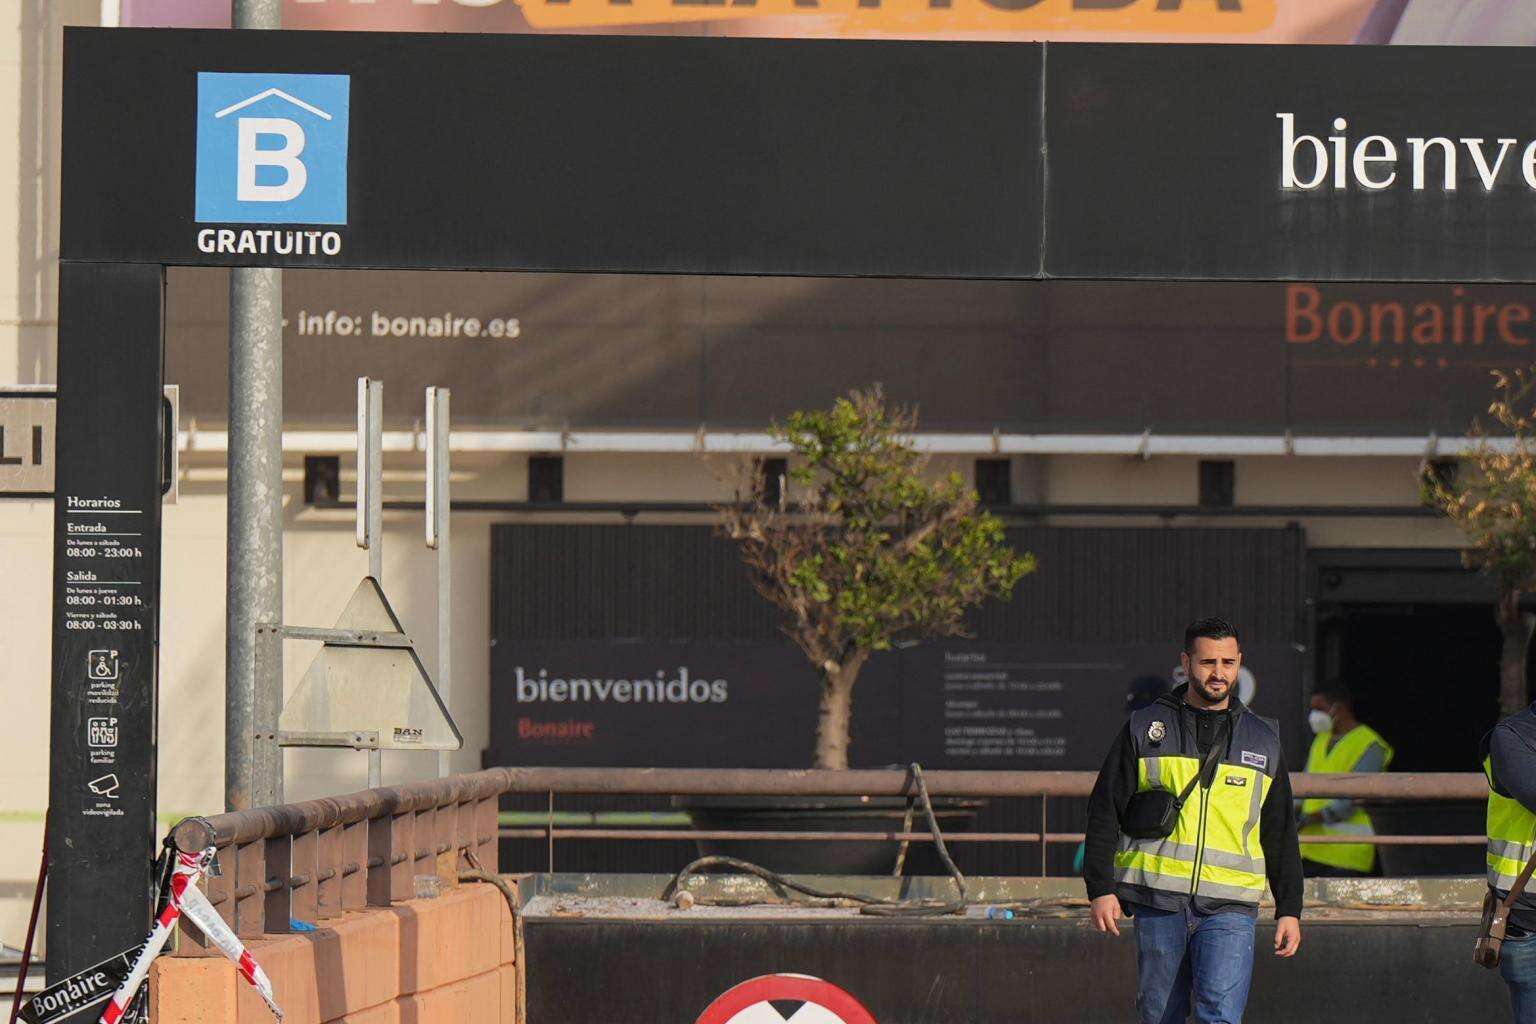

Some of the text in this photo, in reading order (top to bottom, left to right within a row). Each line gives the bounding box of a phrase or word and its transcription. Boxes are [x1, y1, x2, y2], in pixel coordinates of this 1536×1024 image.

[237, 117, 307, 201] B
[198, 229, 341, 256] GRATUITO
[298, 310, 521, 338] info: bonaire.es
[1285, 285, 1531, 345] Bonaire
[67, 496, 121, 508] Horarios
[67, 523, 107, 533] Entrada
[66, 547, 96, 557] 08:00
[104, 547, 133, 557] 23:00
[135, 547, 142, 557] h
[66, 570, 97, 581] Salida
[66, 596, 95, 605] 08:00
[103, 596, 133, 605] 01:30
[134, 595, 142, 605] h
[66, 620, 95, 630] 08:00
[103, 620, 133, 630] 03:30
[134, 619, 142, 630] h
[515, 666, 728, 702] bienvenidos
[518, 717, 596, 738] Bonaire
[32, 968, 110, 1018] Bonaire
